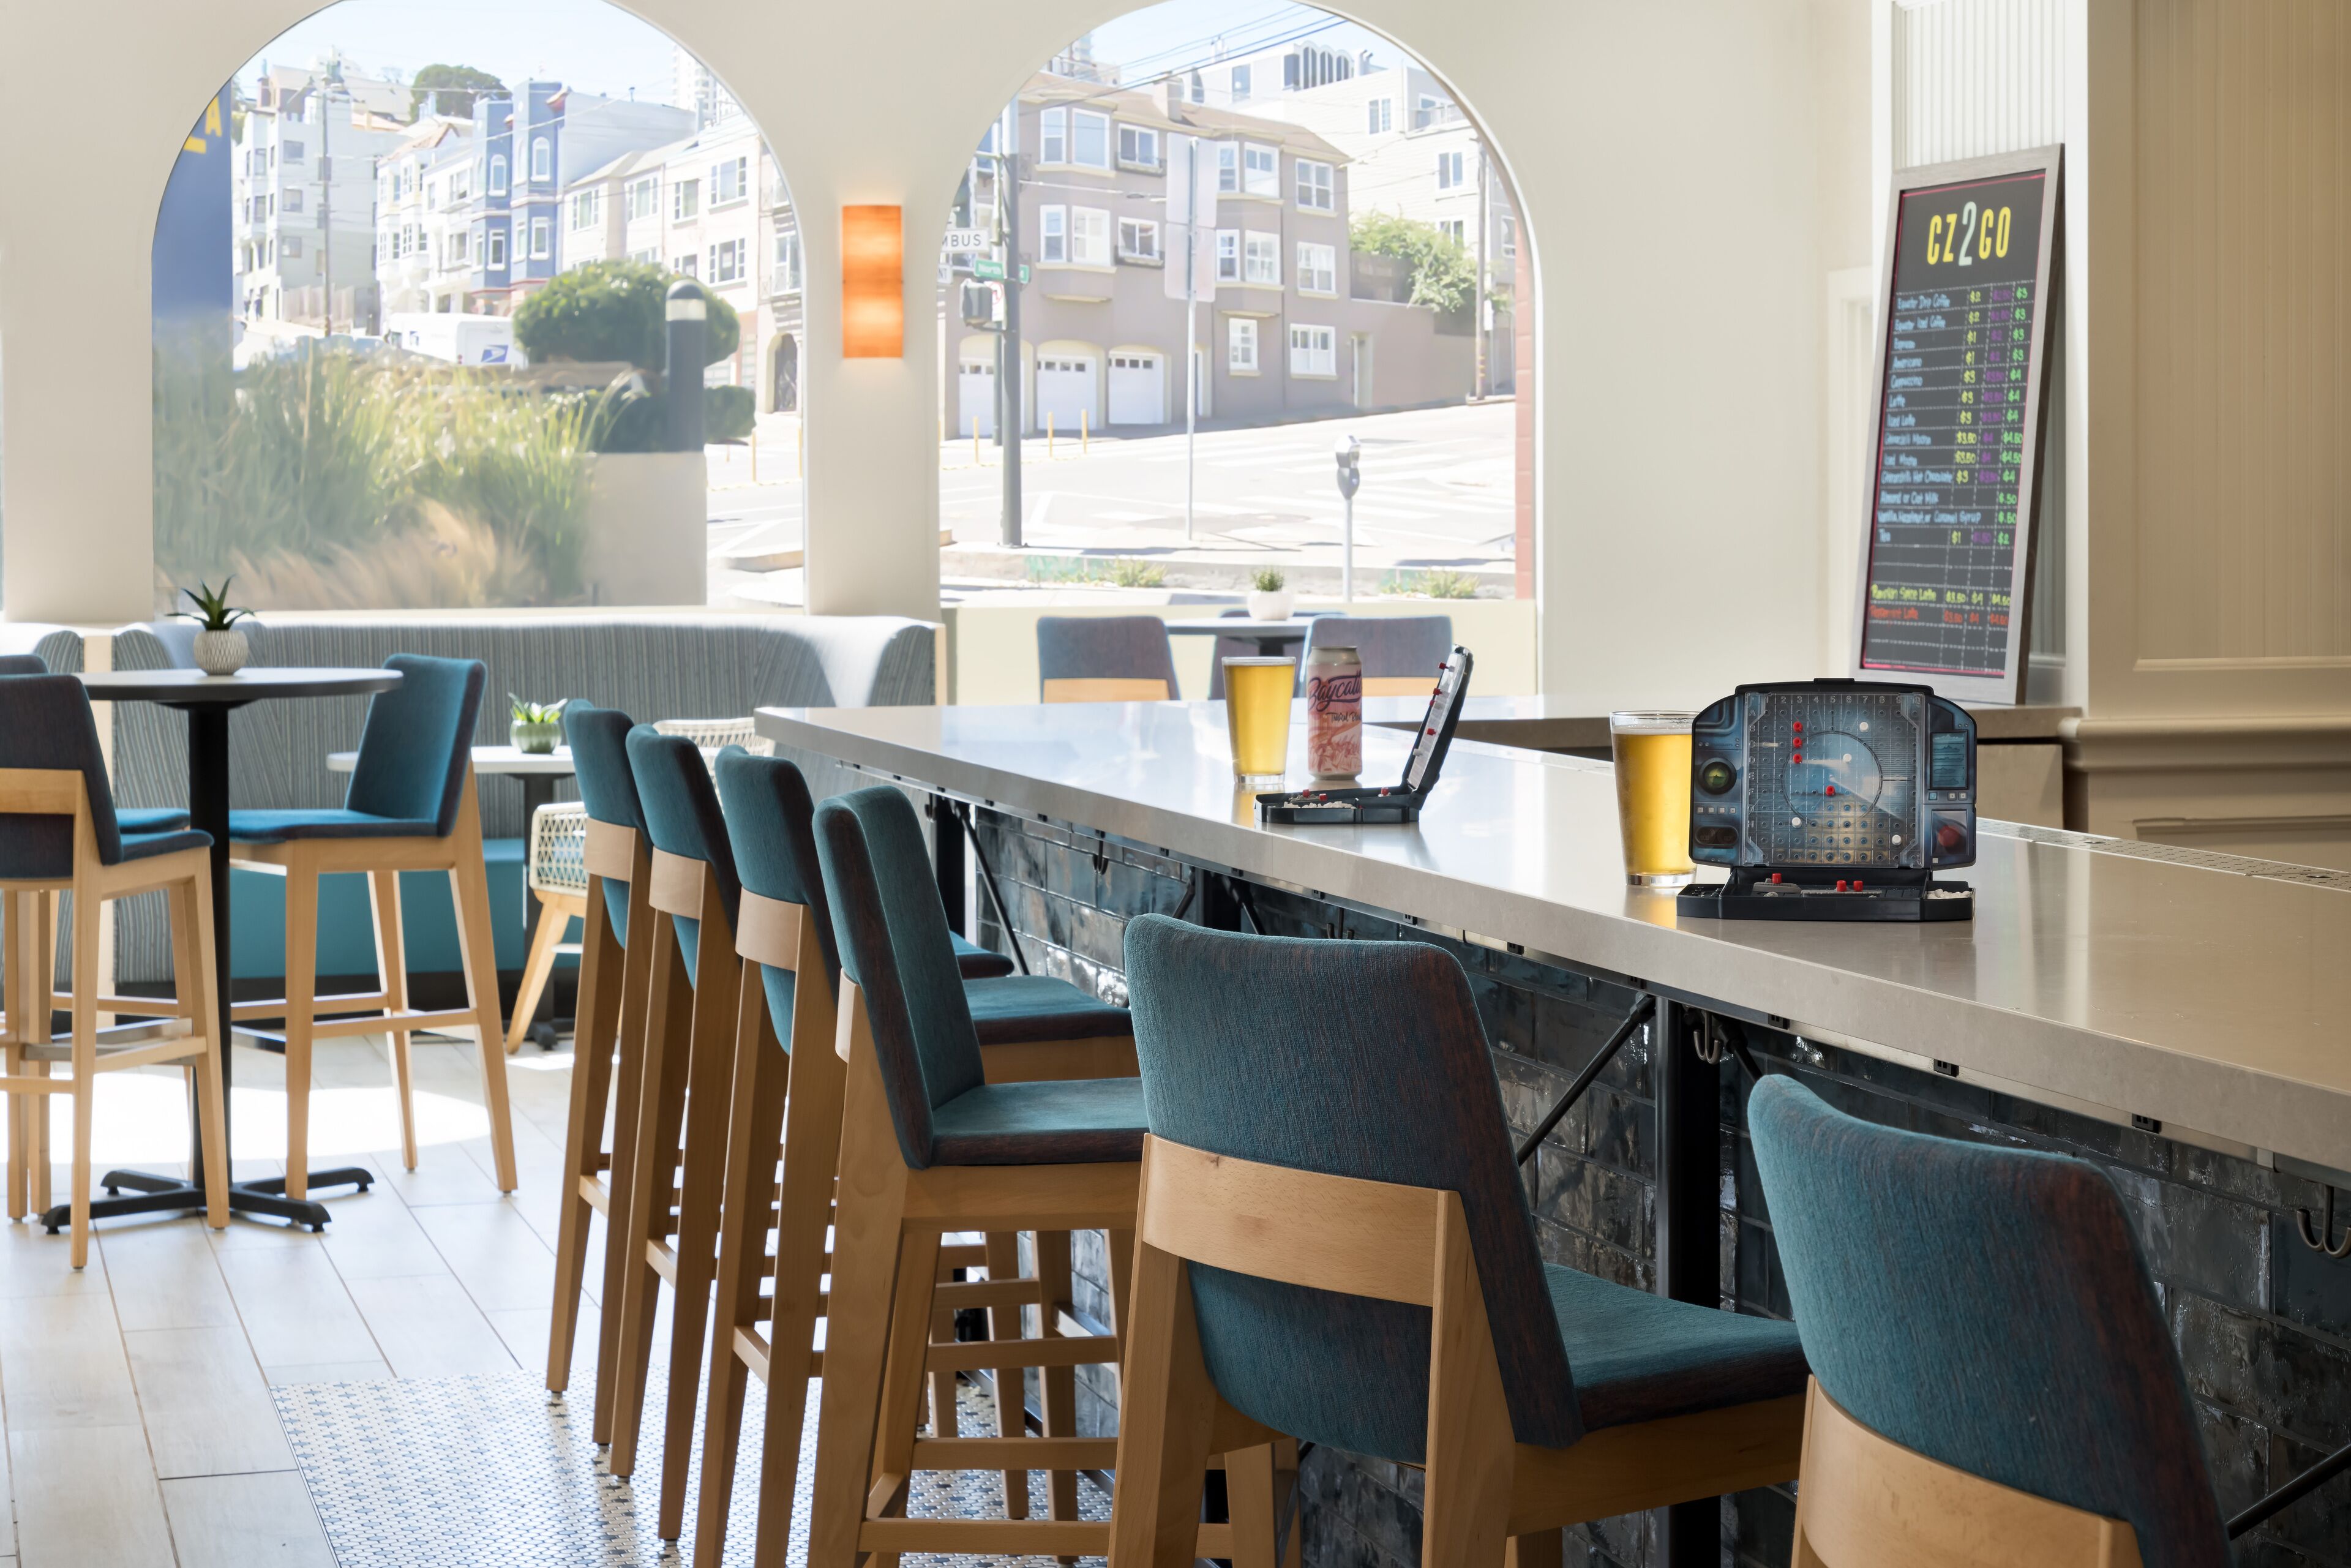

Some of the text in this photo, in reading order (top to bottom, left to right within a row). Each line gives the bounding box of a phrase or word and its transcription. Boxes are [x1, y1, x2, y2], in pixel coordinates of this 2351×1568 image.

[1970, 290, 1981, 303] $2
[2016, 287, 2028, 299] $3
[1968, 311, 1979, 324] $2
[2014, 307, 2026, 320] $3
[1967, 329, 1976, 345] $1
[2012, 328, 2025, 341] $3
[1965, 350, 1974, 366] $1
[2012, 348, 2023, 361] $3
[1963, 370, 1975, 383] $3
[2010, 368, 2021, 381] $4
[1962, 390, 1973, 403] $3
[2008, 388, 2020, 402] $4
[1960, 410, 1972, 424] $3
[2006, 408, 2019, 422] $4
[1956, 470, 1968, 484] $3
[2003, 469, 2015, 483] $4
[1952, 530, 1961, 545] $1
[1998, 531, 2009, 545] $2
